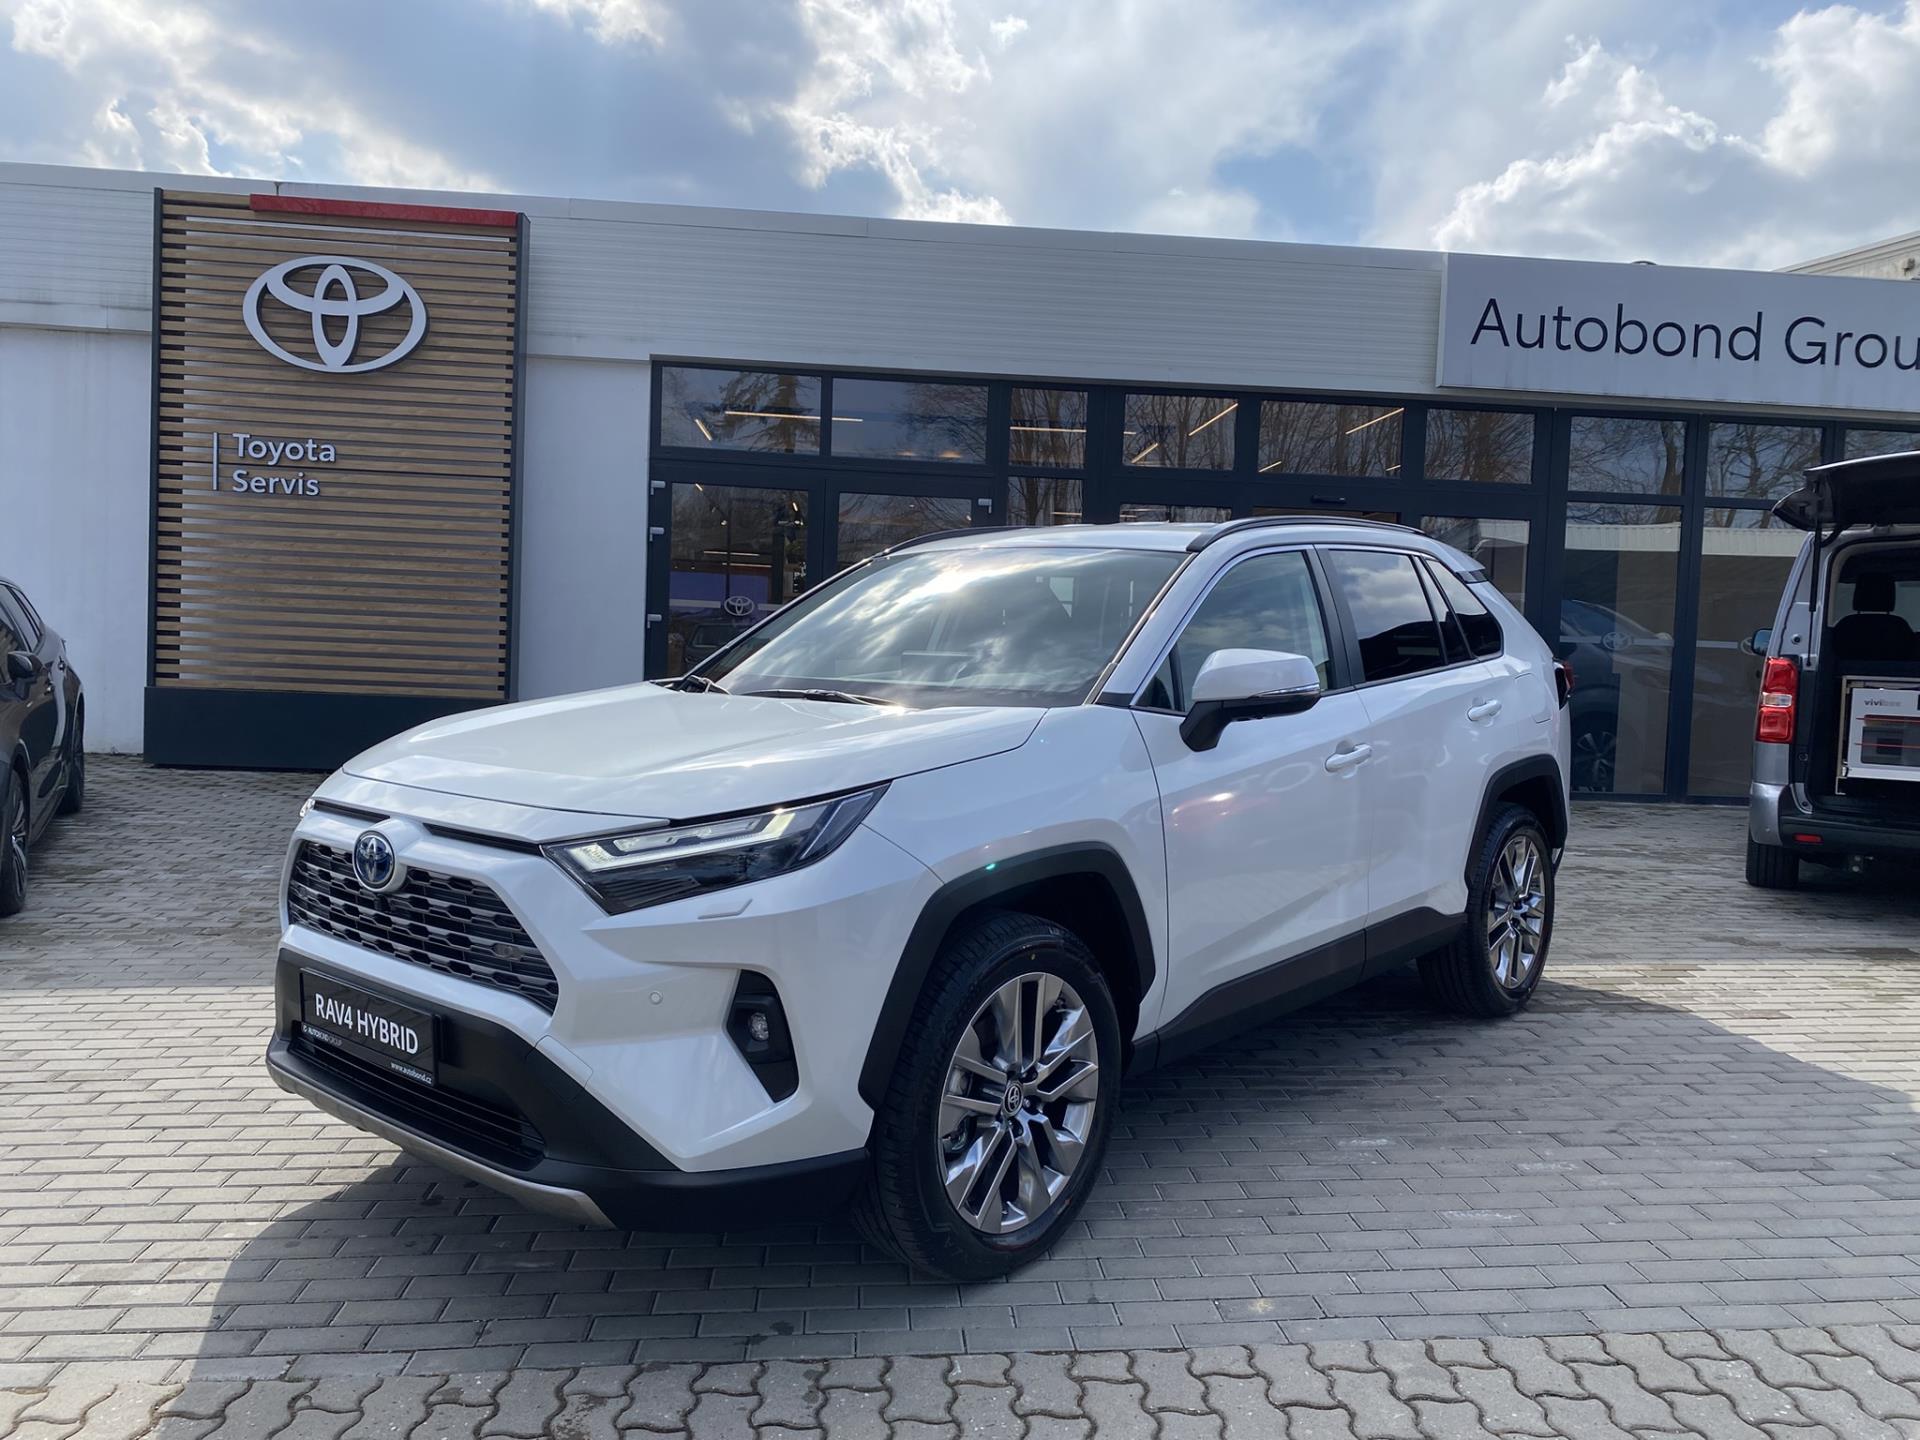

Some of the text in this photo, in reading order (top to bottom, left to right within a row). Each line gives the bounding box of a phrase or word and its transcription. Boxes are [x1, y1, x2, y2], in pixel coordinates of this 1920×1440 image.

[1470, 298, 1763, 362] Autobond
[232, 433, 336, 466] Toyota
[232, 469, 319, 496] Servis
[315, 993, 419, 1055] RAV4 HYBRID
